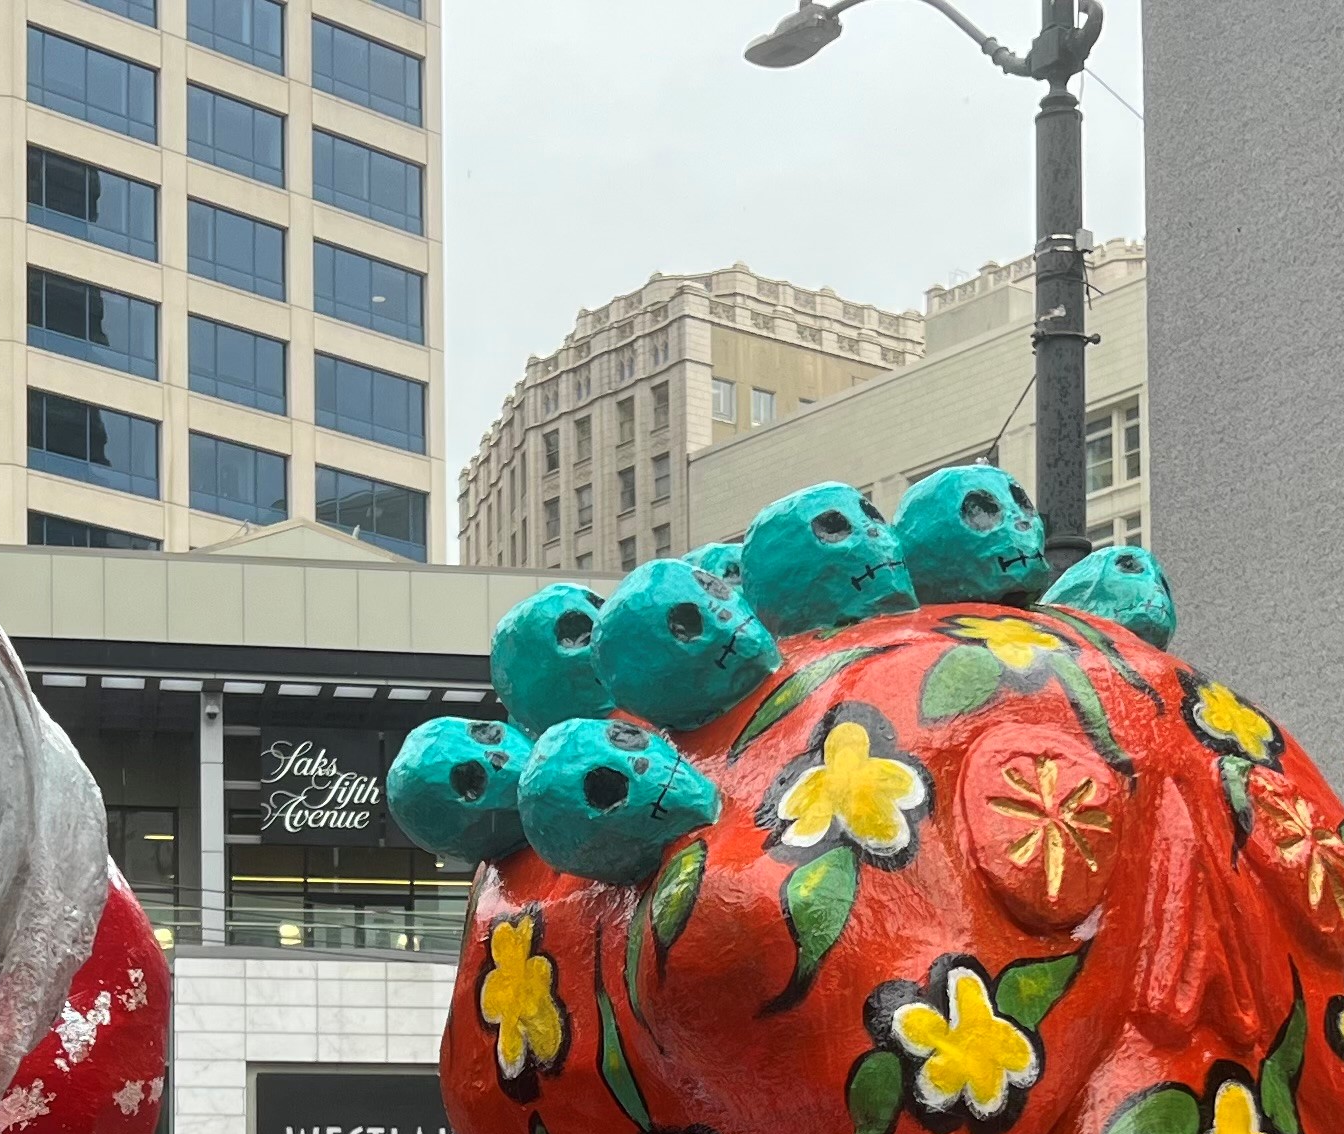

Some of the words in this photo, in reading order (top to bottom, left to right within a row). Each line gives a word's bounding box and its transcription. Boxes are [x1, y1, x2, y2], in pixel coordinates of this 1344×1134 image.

[261, 741, 337, 783] Saks
[261, 790, 370, 832] Avenue
[301, 772, 380, 809] Fifth
